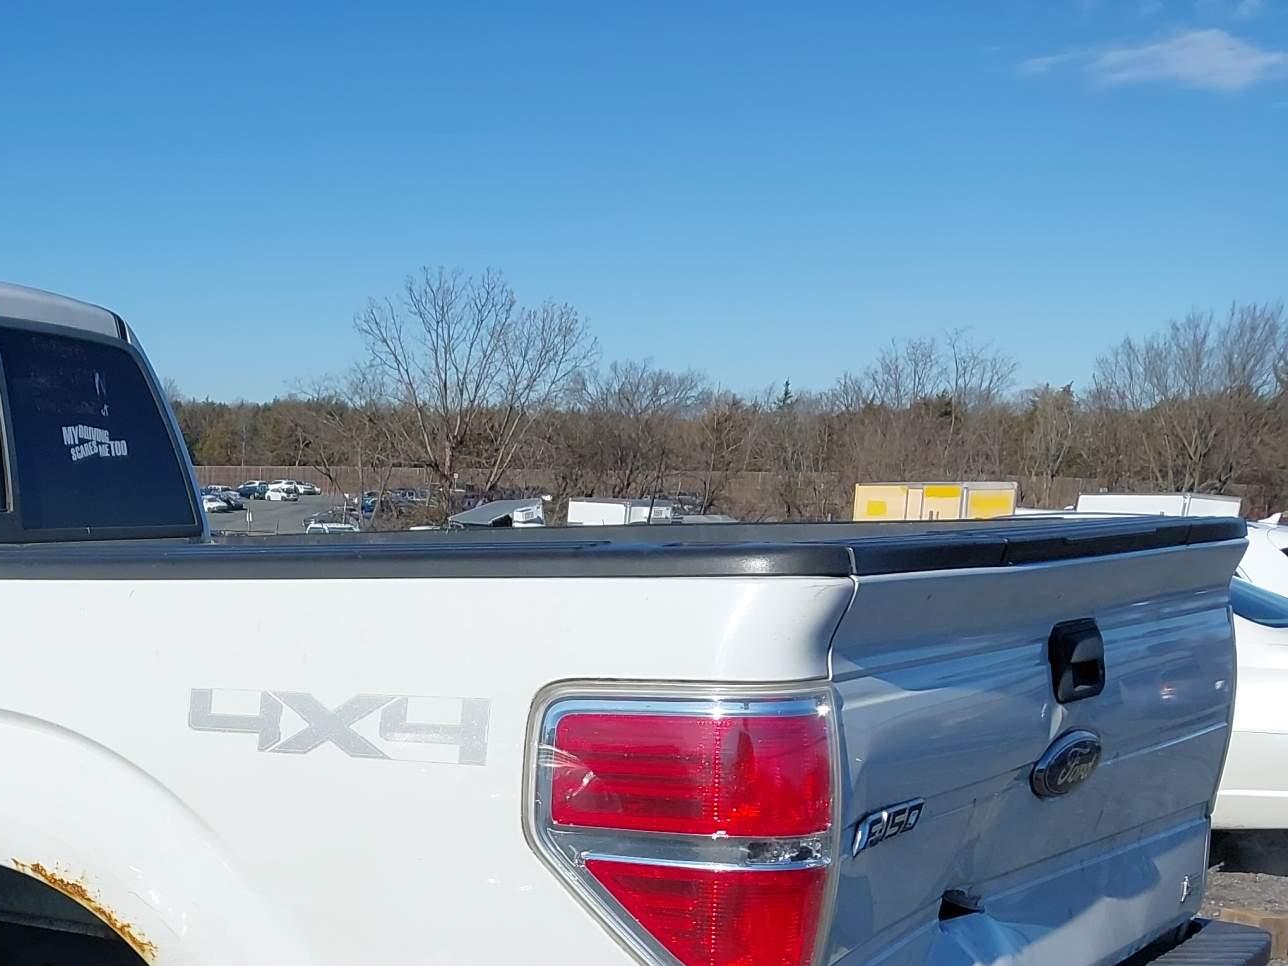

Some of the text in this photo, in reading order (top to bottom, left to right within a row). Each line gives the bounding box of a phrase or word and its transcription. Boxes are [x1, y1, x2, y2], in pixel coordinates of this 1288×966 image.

[62, 423, 110, 445] MY DRIVING
[70, 440, 128, 461] SCARES ME TOO
